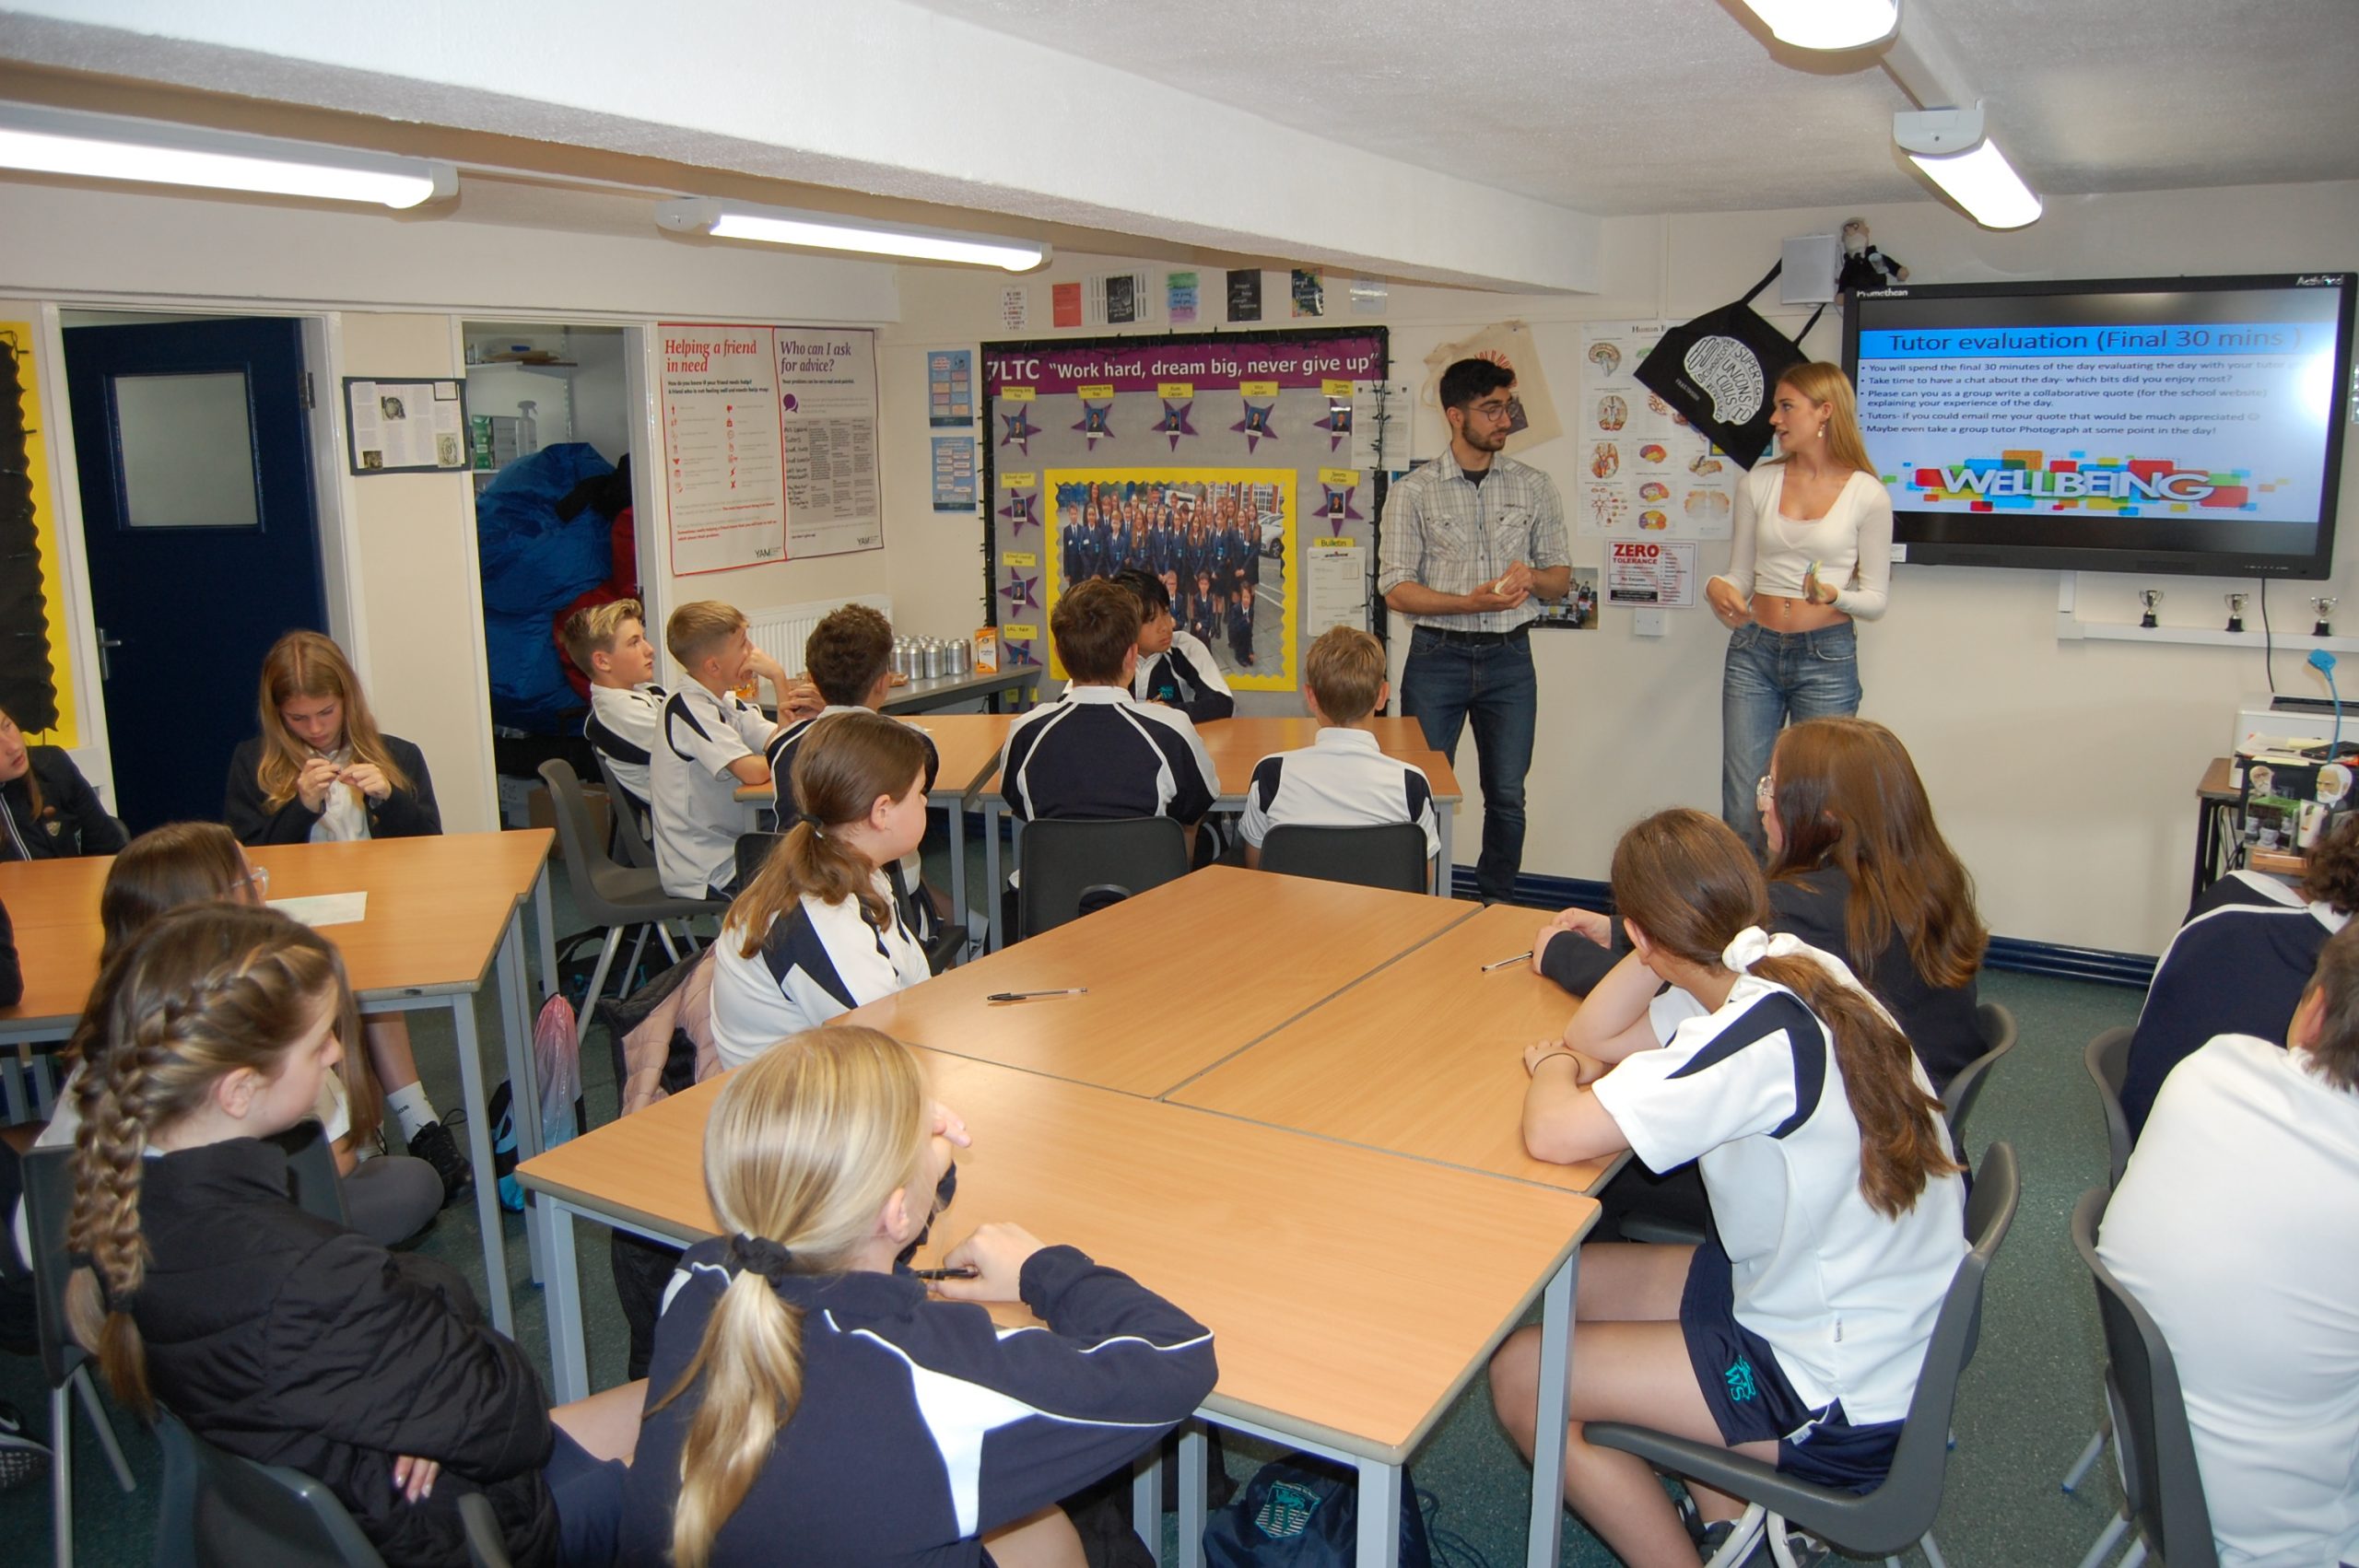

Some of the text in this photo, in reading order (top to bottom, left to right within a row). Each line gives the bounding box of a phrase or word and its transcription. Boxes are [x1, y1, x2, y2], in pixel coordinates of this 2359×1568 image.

[1889, 335, 1952, 351] Tutor
[1959, 333, 2087, 349] evaluation
[2097, 331, 2167, 351] (Final
[2176, 330, 2210, 347] 30
[2218, 329, 2283, 346] mins
[664, 339, 757, 357] Helping a friend
[780, 341, 851, 356] Who can I ask
[667, 357, 708, 372] in need
[780, 357, 835, 375] for advice?
[987, 359, 1040, 381] 7LTC
[1105, 361, 1146, 379] hard,
[1152, 360, 1205, 376] dream
[1211, 357, 1243, 378] big,
[1248, 360, 1297, 373] never
[1302, 356, 1341, 376] give
[1908, 364, 1938, 373] spend
[1959, 363, 1980, 371] final
[2076, 363, 2095, 371] day
[2098, 362, 2154, 371] evaluating
[2177, 362, 2197, 370] day
[2227, 362, 2255, 370] your
[1722, 358, 1752, 404] UNCONS
[2041, 376, 2063, 385] day-
[2165, 376, 2195, 384] enjoy
[2137, 390, 2155, 398] (for
[2219, 390, 2267, 398] website)
[1867, 400, 1916, 408] explaining
[1943, 400, 1998, 408] experience
[2033, 400, 2053, 408] day.
[1732, 407, 1752, 422] ID
[2178, 414, 2244, 422] appreciated
[1866, 426, 1898, 434] Maybe
[1958, 427, 1989, 435] group
[2019, 426, 2079, 435] Photograph
[2127, 427, 2154, 435] point
[2192, 427, 2216, 436] day!
[1939, 468, 2215, 501] WELLBEING
[1320, 539, 1347, 547] Bulletin
[755, 548, 771, 558] YAM
[1614, 544, 1661, 558] ZERO
